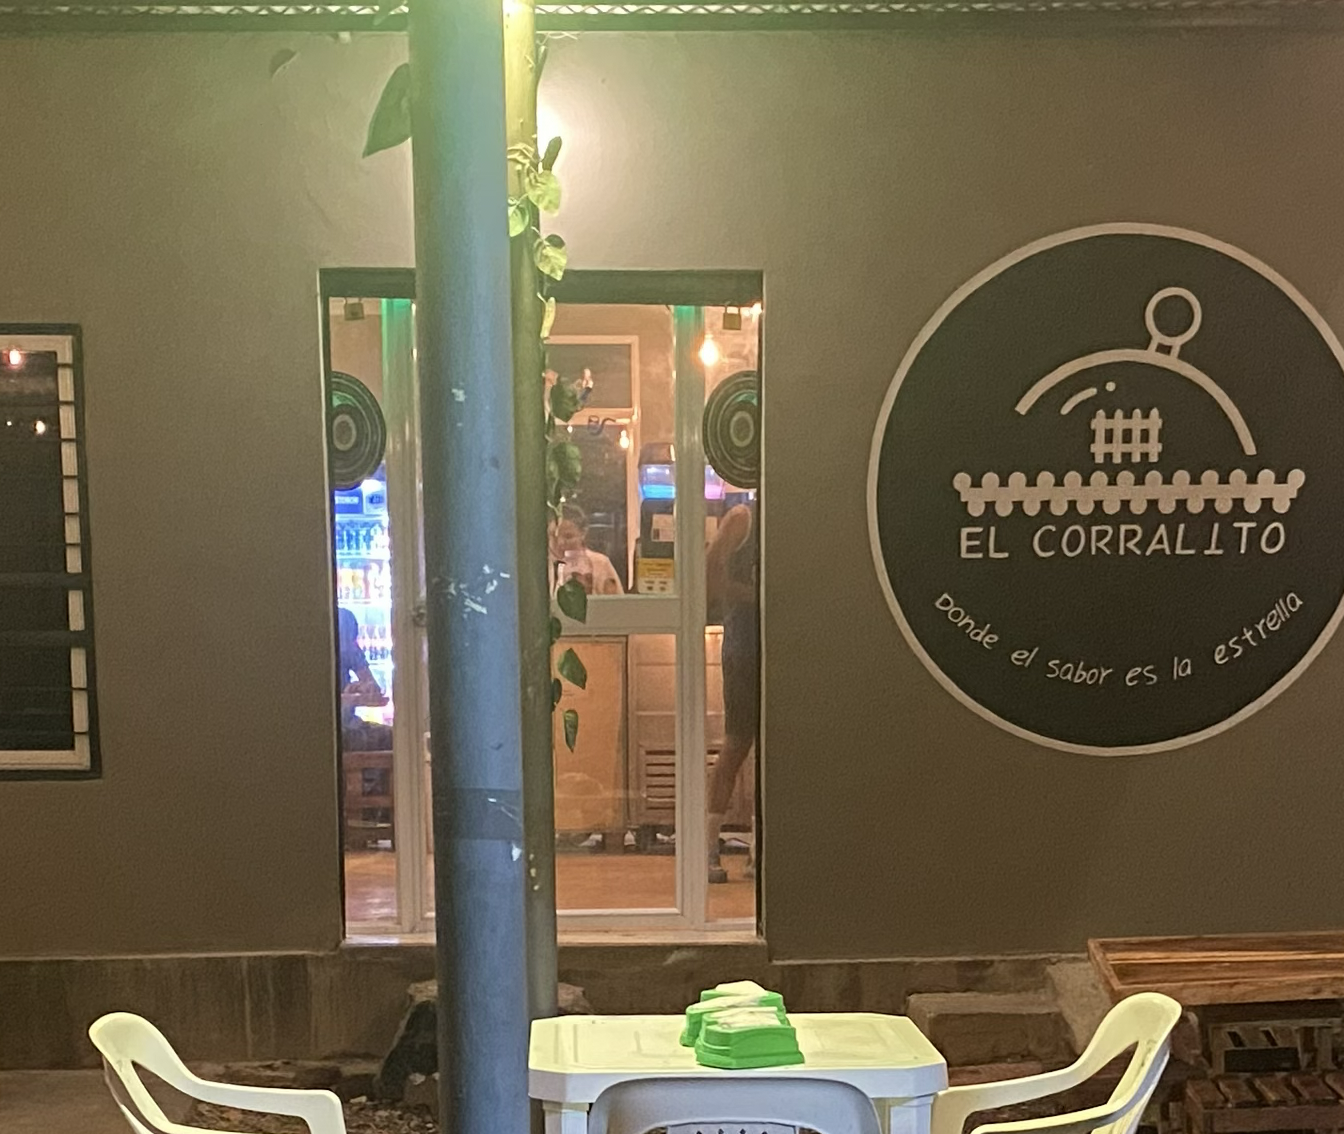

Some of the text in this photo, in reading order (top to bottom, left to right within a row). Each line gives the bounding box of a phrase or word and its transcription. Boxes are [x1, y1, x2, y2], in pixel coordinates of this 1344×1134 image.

[960, 521, 1286, 559] EL CORRALITO
[933, 590, 1304, 687] Donde el sabor es la estrella
